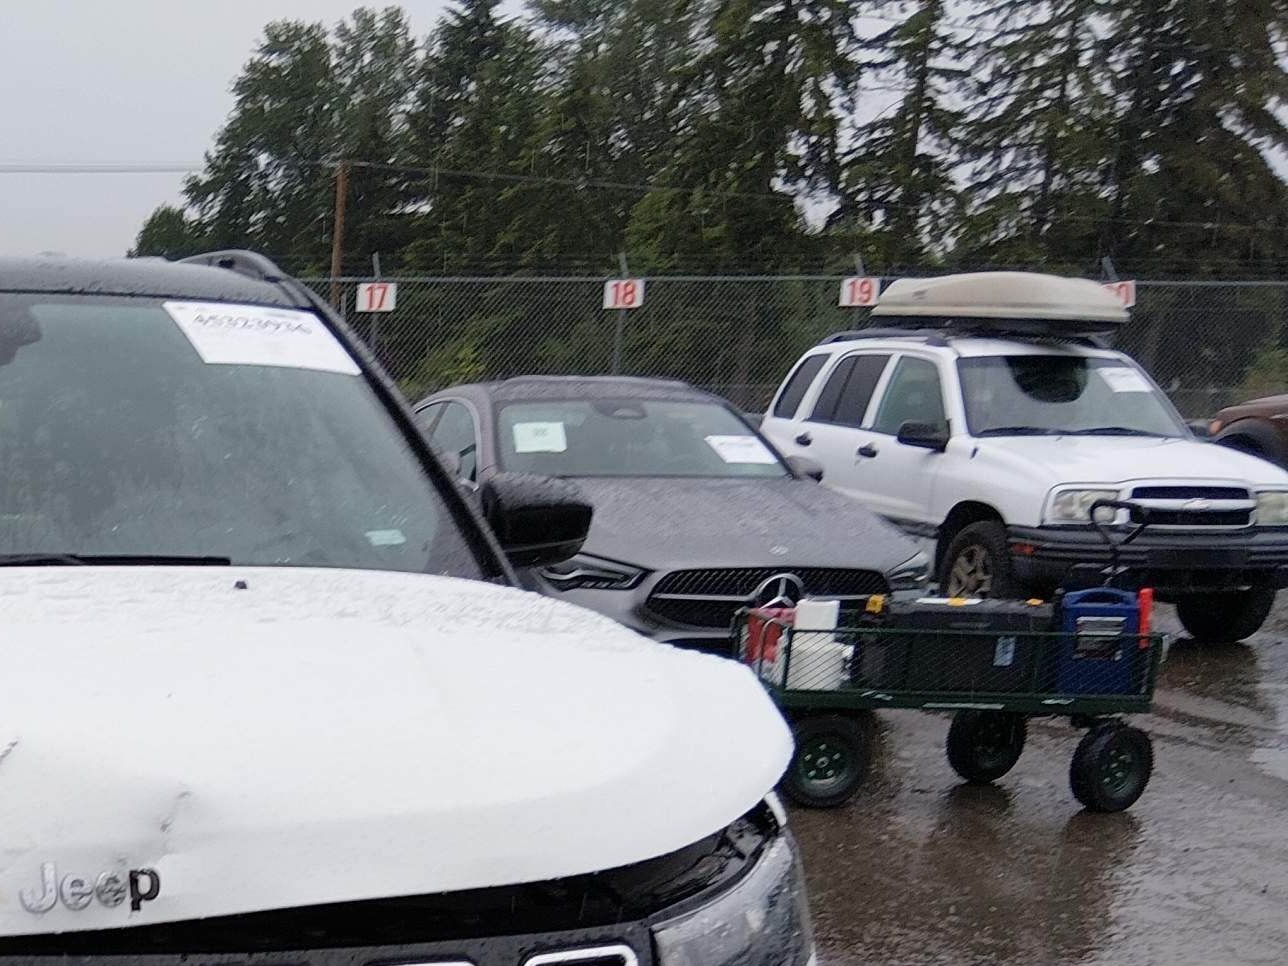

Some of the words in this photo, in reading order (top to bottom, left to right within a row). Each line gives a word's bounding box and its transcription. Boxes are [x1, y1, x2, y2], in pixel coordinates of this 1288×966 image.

[367, 284, 389, 310] 17
[612, 280, 636, 306] 18
[848, 279, 873, 304] 19
[19, 862, 161, 914] Jeep
